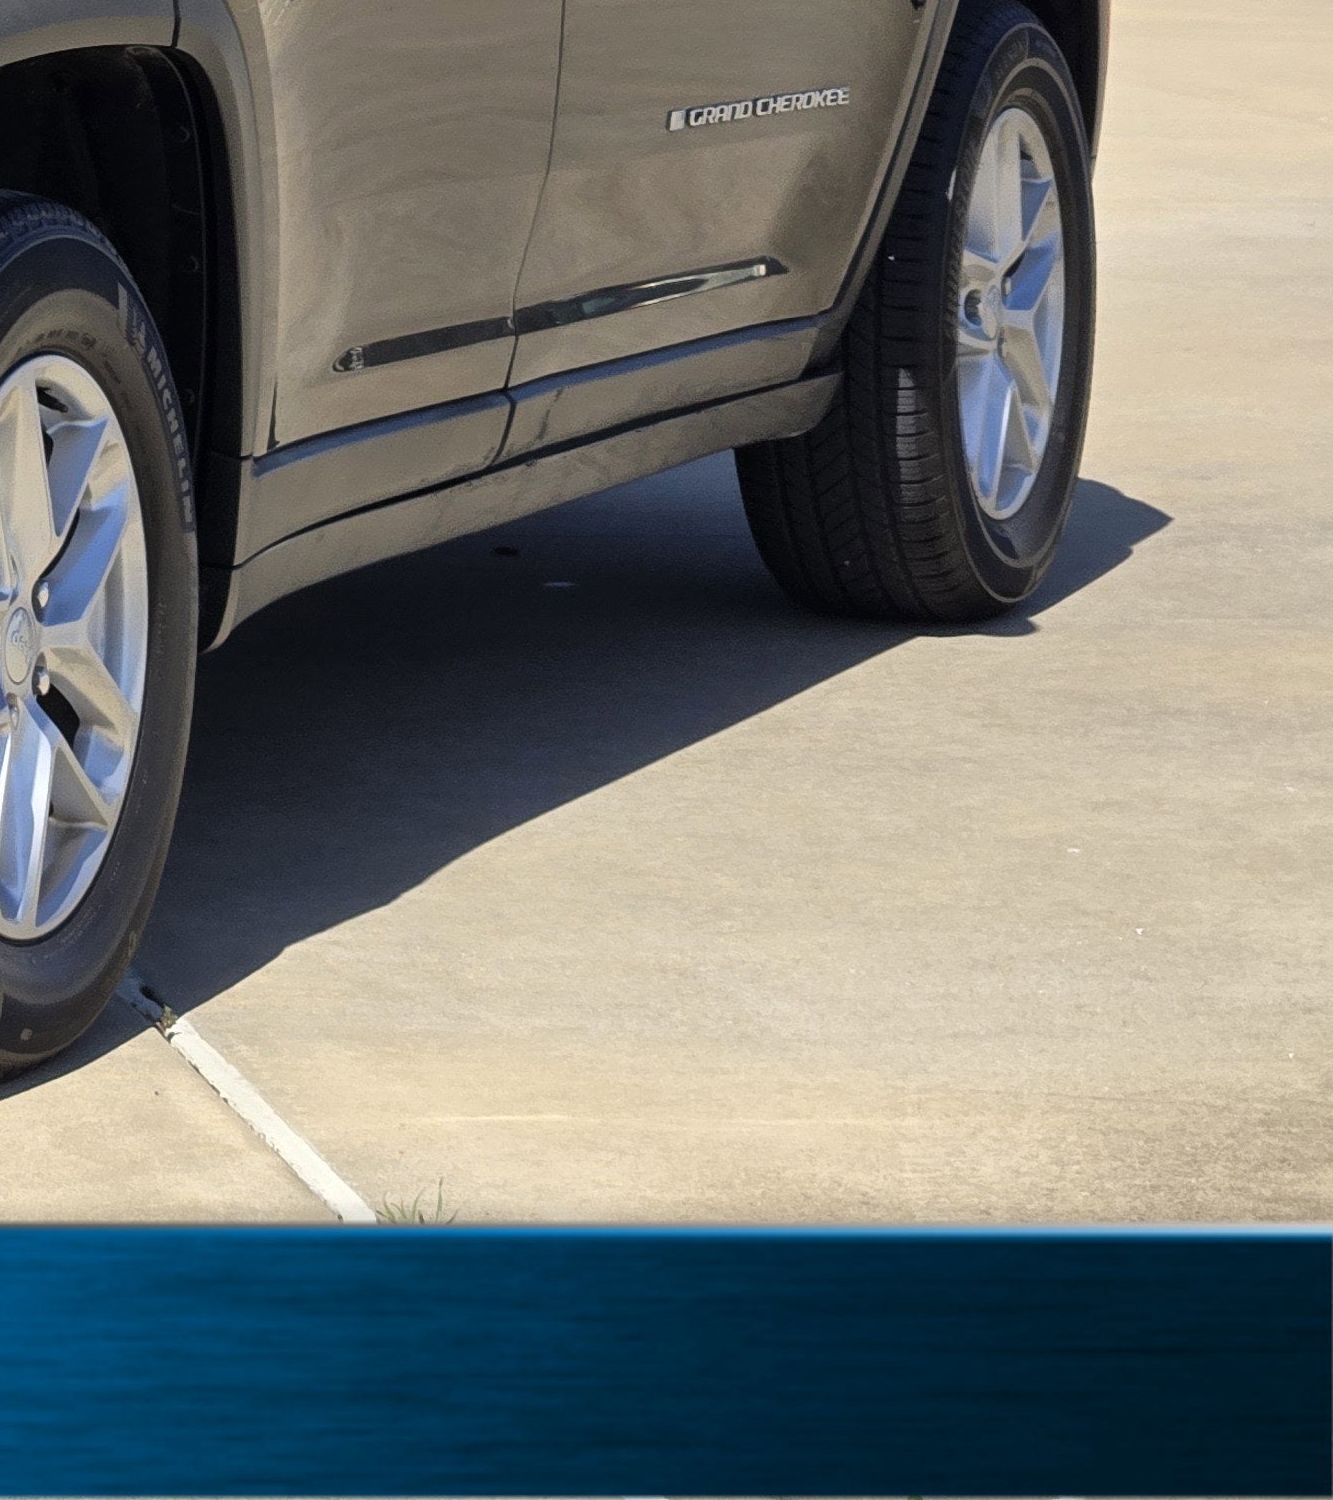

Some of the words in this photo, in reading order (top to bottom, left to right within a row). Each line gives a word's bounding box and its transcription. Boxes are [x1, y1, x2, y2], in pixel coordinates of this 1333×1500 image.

[687, 100, 754, 127] GRAND
[755, 86, 851, 116] CHEROKEE
[147, 346, 194, 523] MICHELIN
